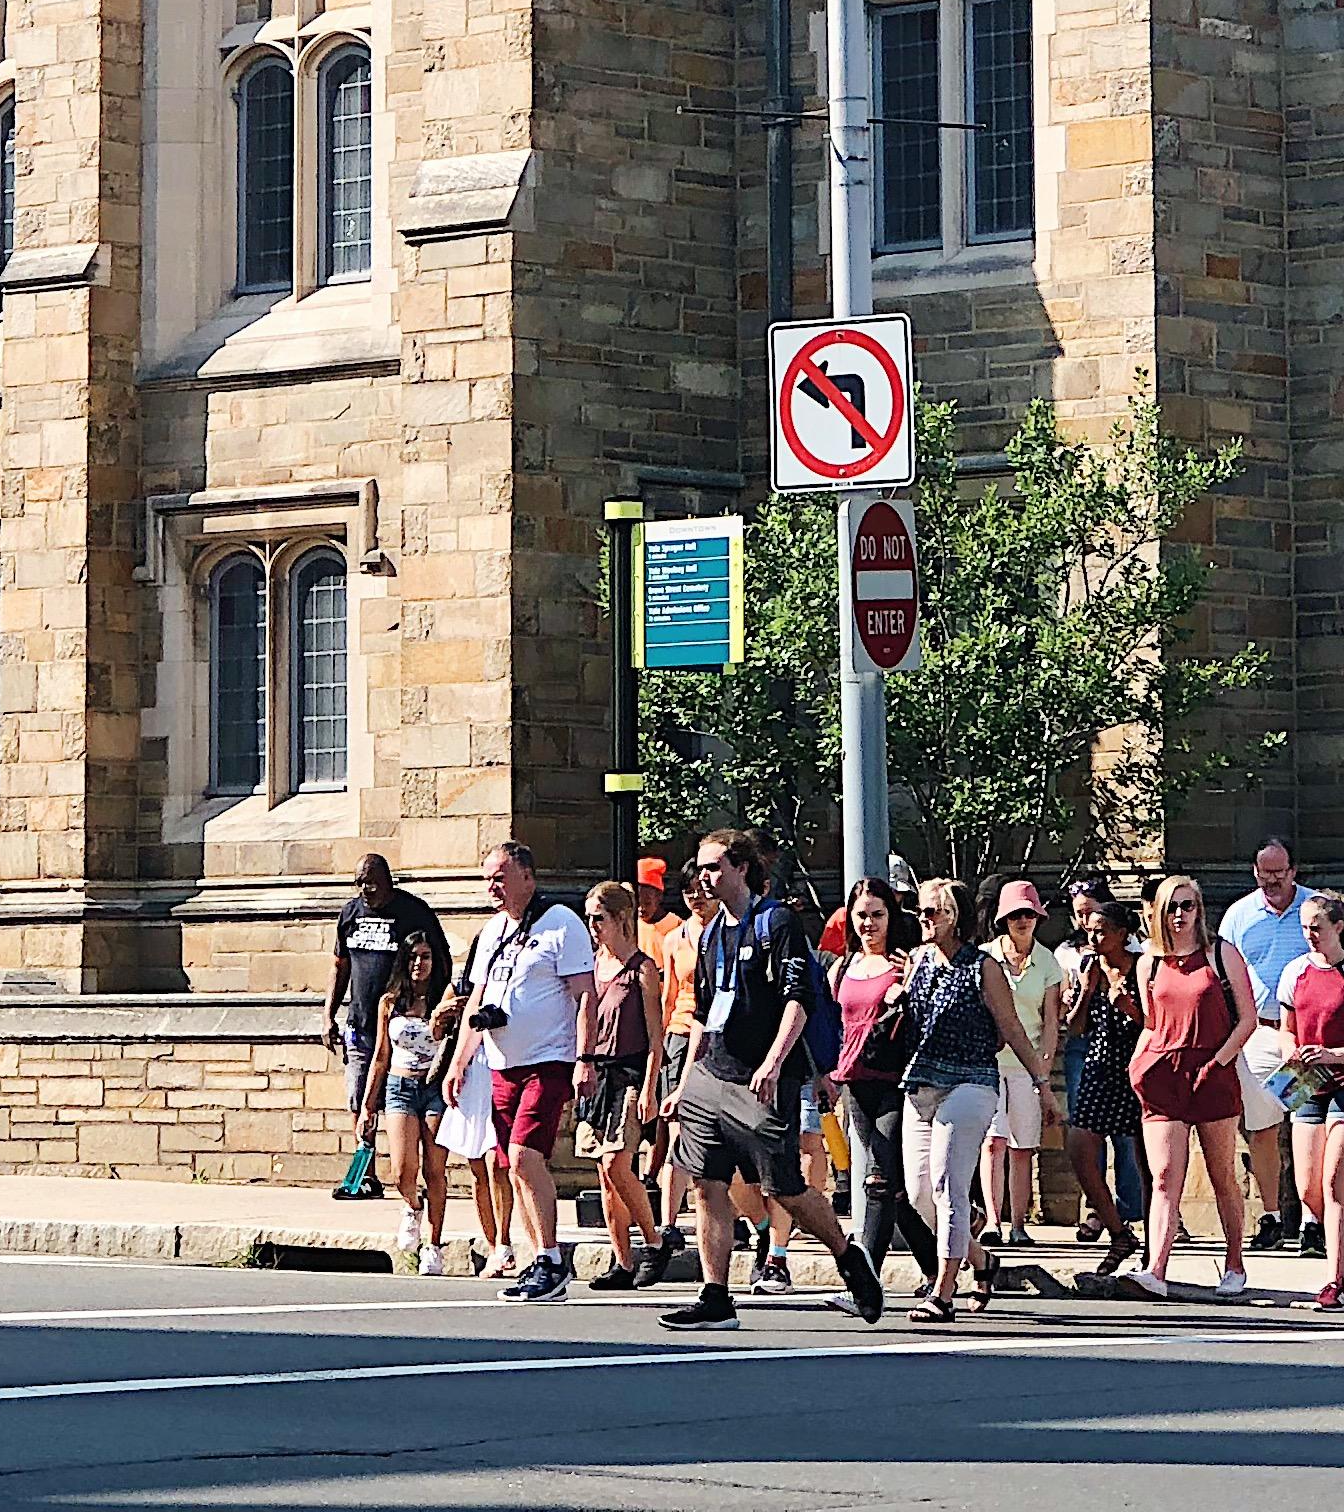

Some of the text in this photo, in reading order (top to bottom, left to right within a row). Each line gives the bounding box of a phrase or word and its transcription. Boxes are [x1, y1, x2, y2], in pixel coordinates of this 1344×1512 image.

[859, 535, 906, 560] DO NOT
[867, 609, 905, 635] ENTER
